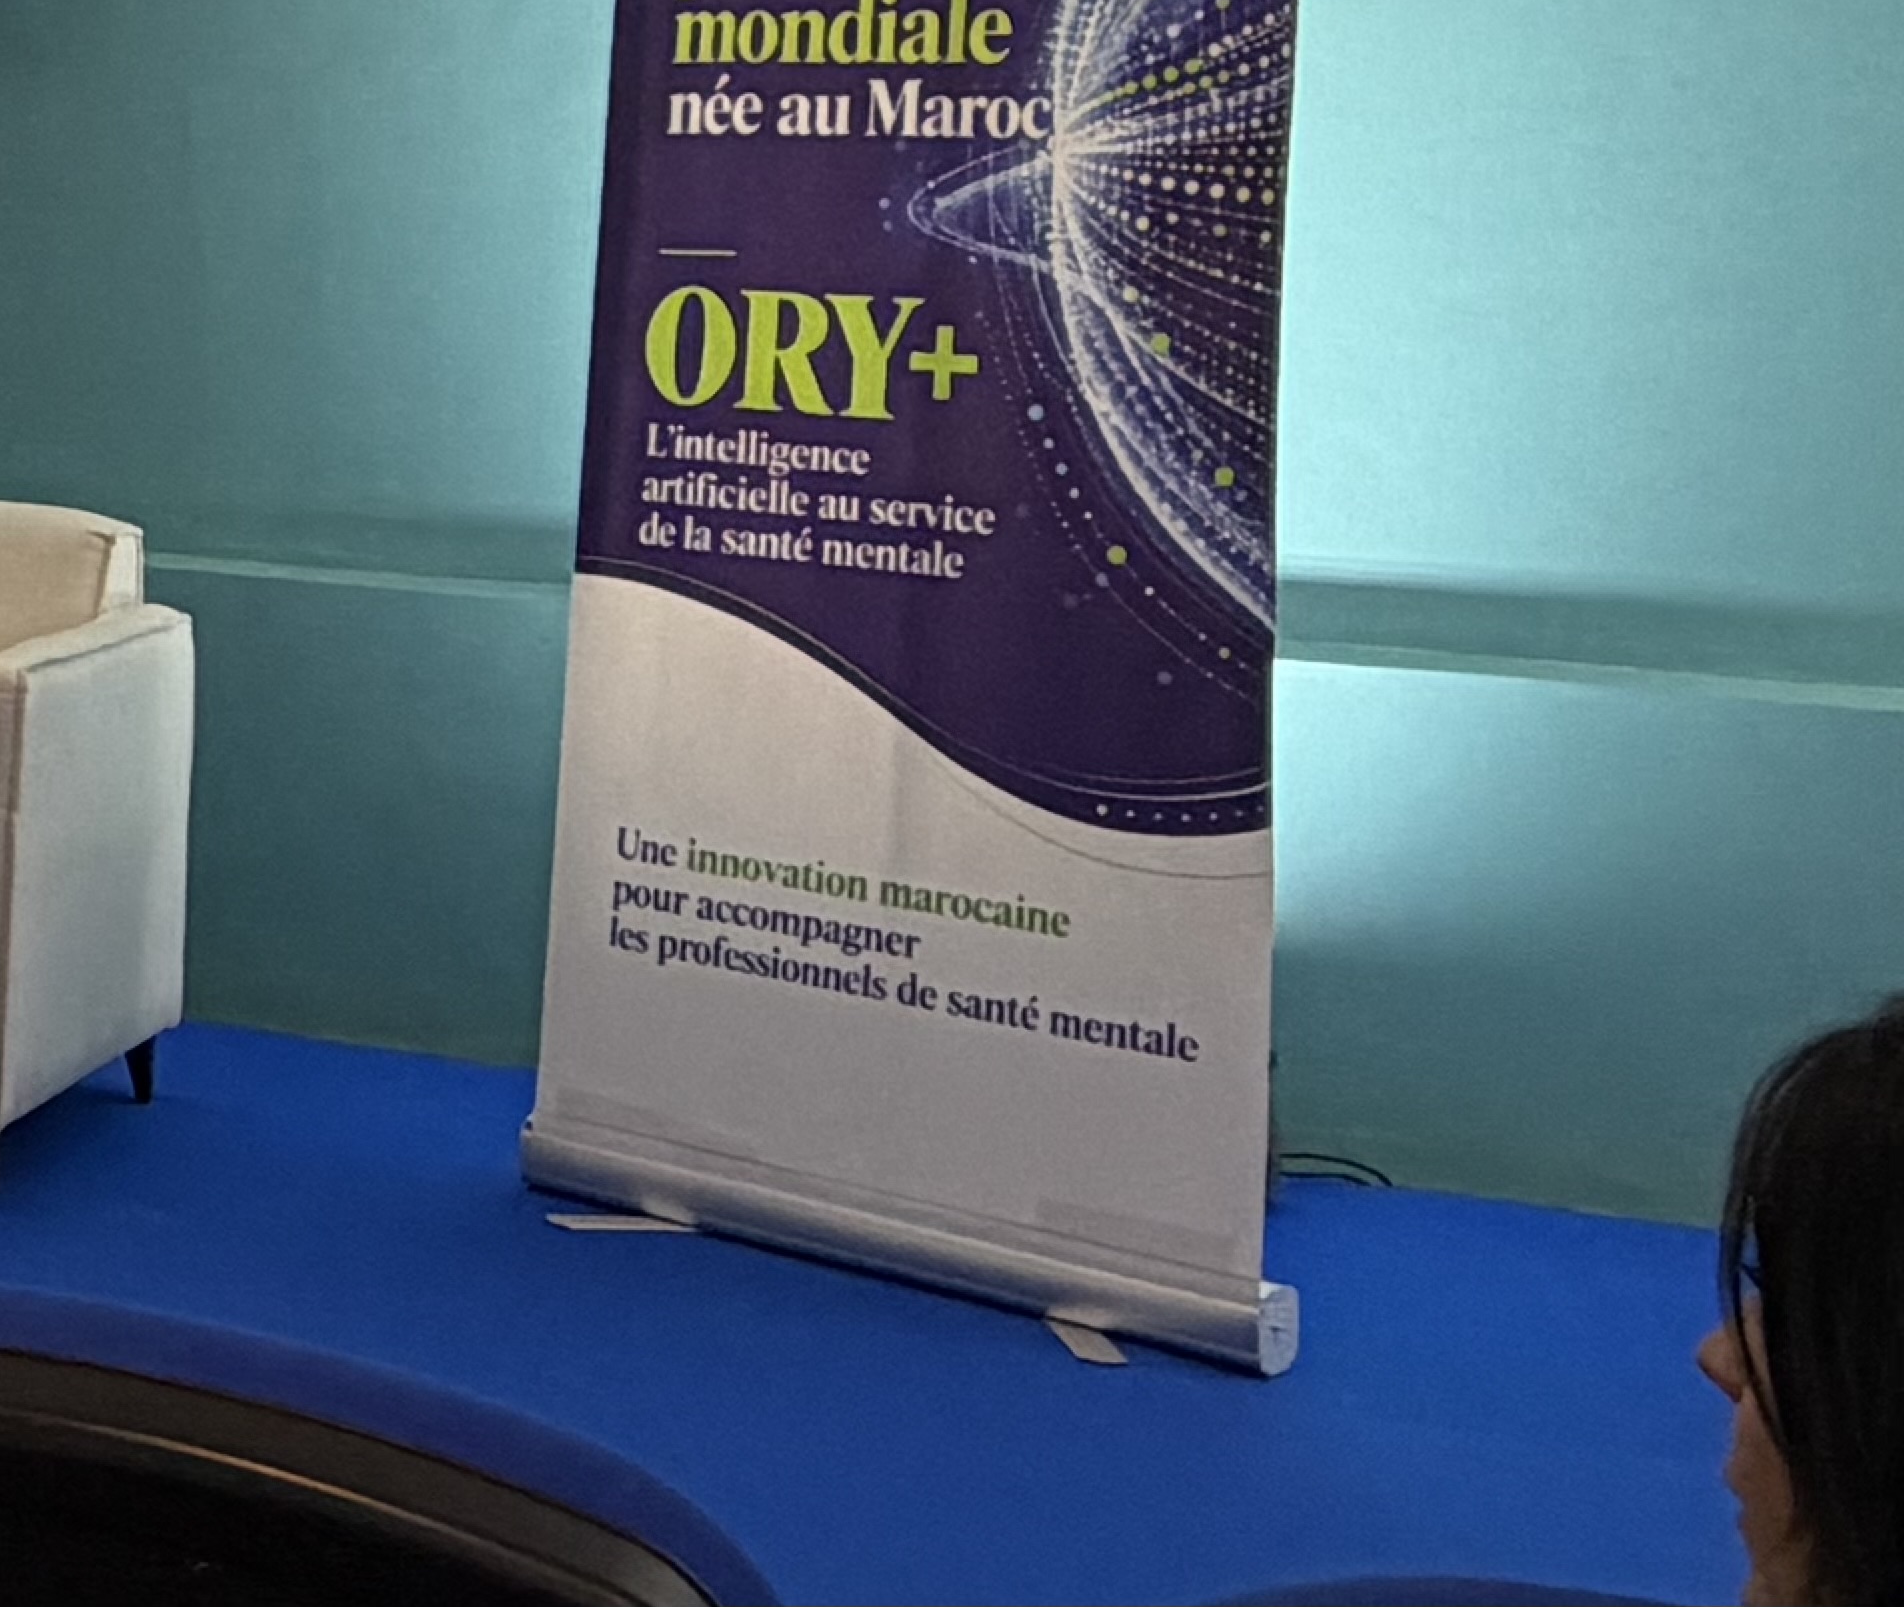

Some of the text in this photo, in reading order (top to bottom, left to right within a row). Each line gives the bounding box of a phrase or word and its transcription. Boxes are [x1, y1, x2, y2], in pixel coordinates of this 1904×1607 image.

[666, 73, 1052, 140] née au Maroc
[645, 285, 979, 421] ORY+
[647, 422, 871, 476] L'intelligence
[640, 472, 996, 535] artificielle au service
[639, 511, 966, 579] de la santé mentale
[612, 879, 922, 958] pour accompagner
[617, 826, 1072, 939] Une innovation marocaine
[609, 915, 1200, 1064] les professionnels de santé mentale
